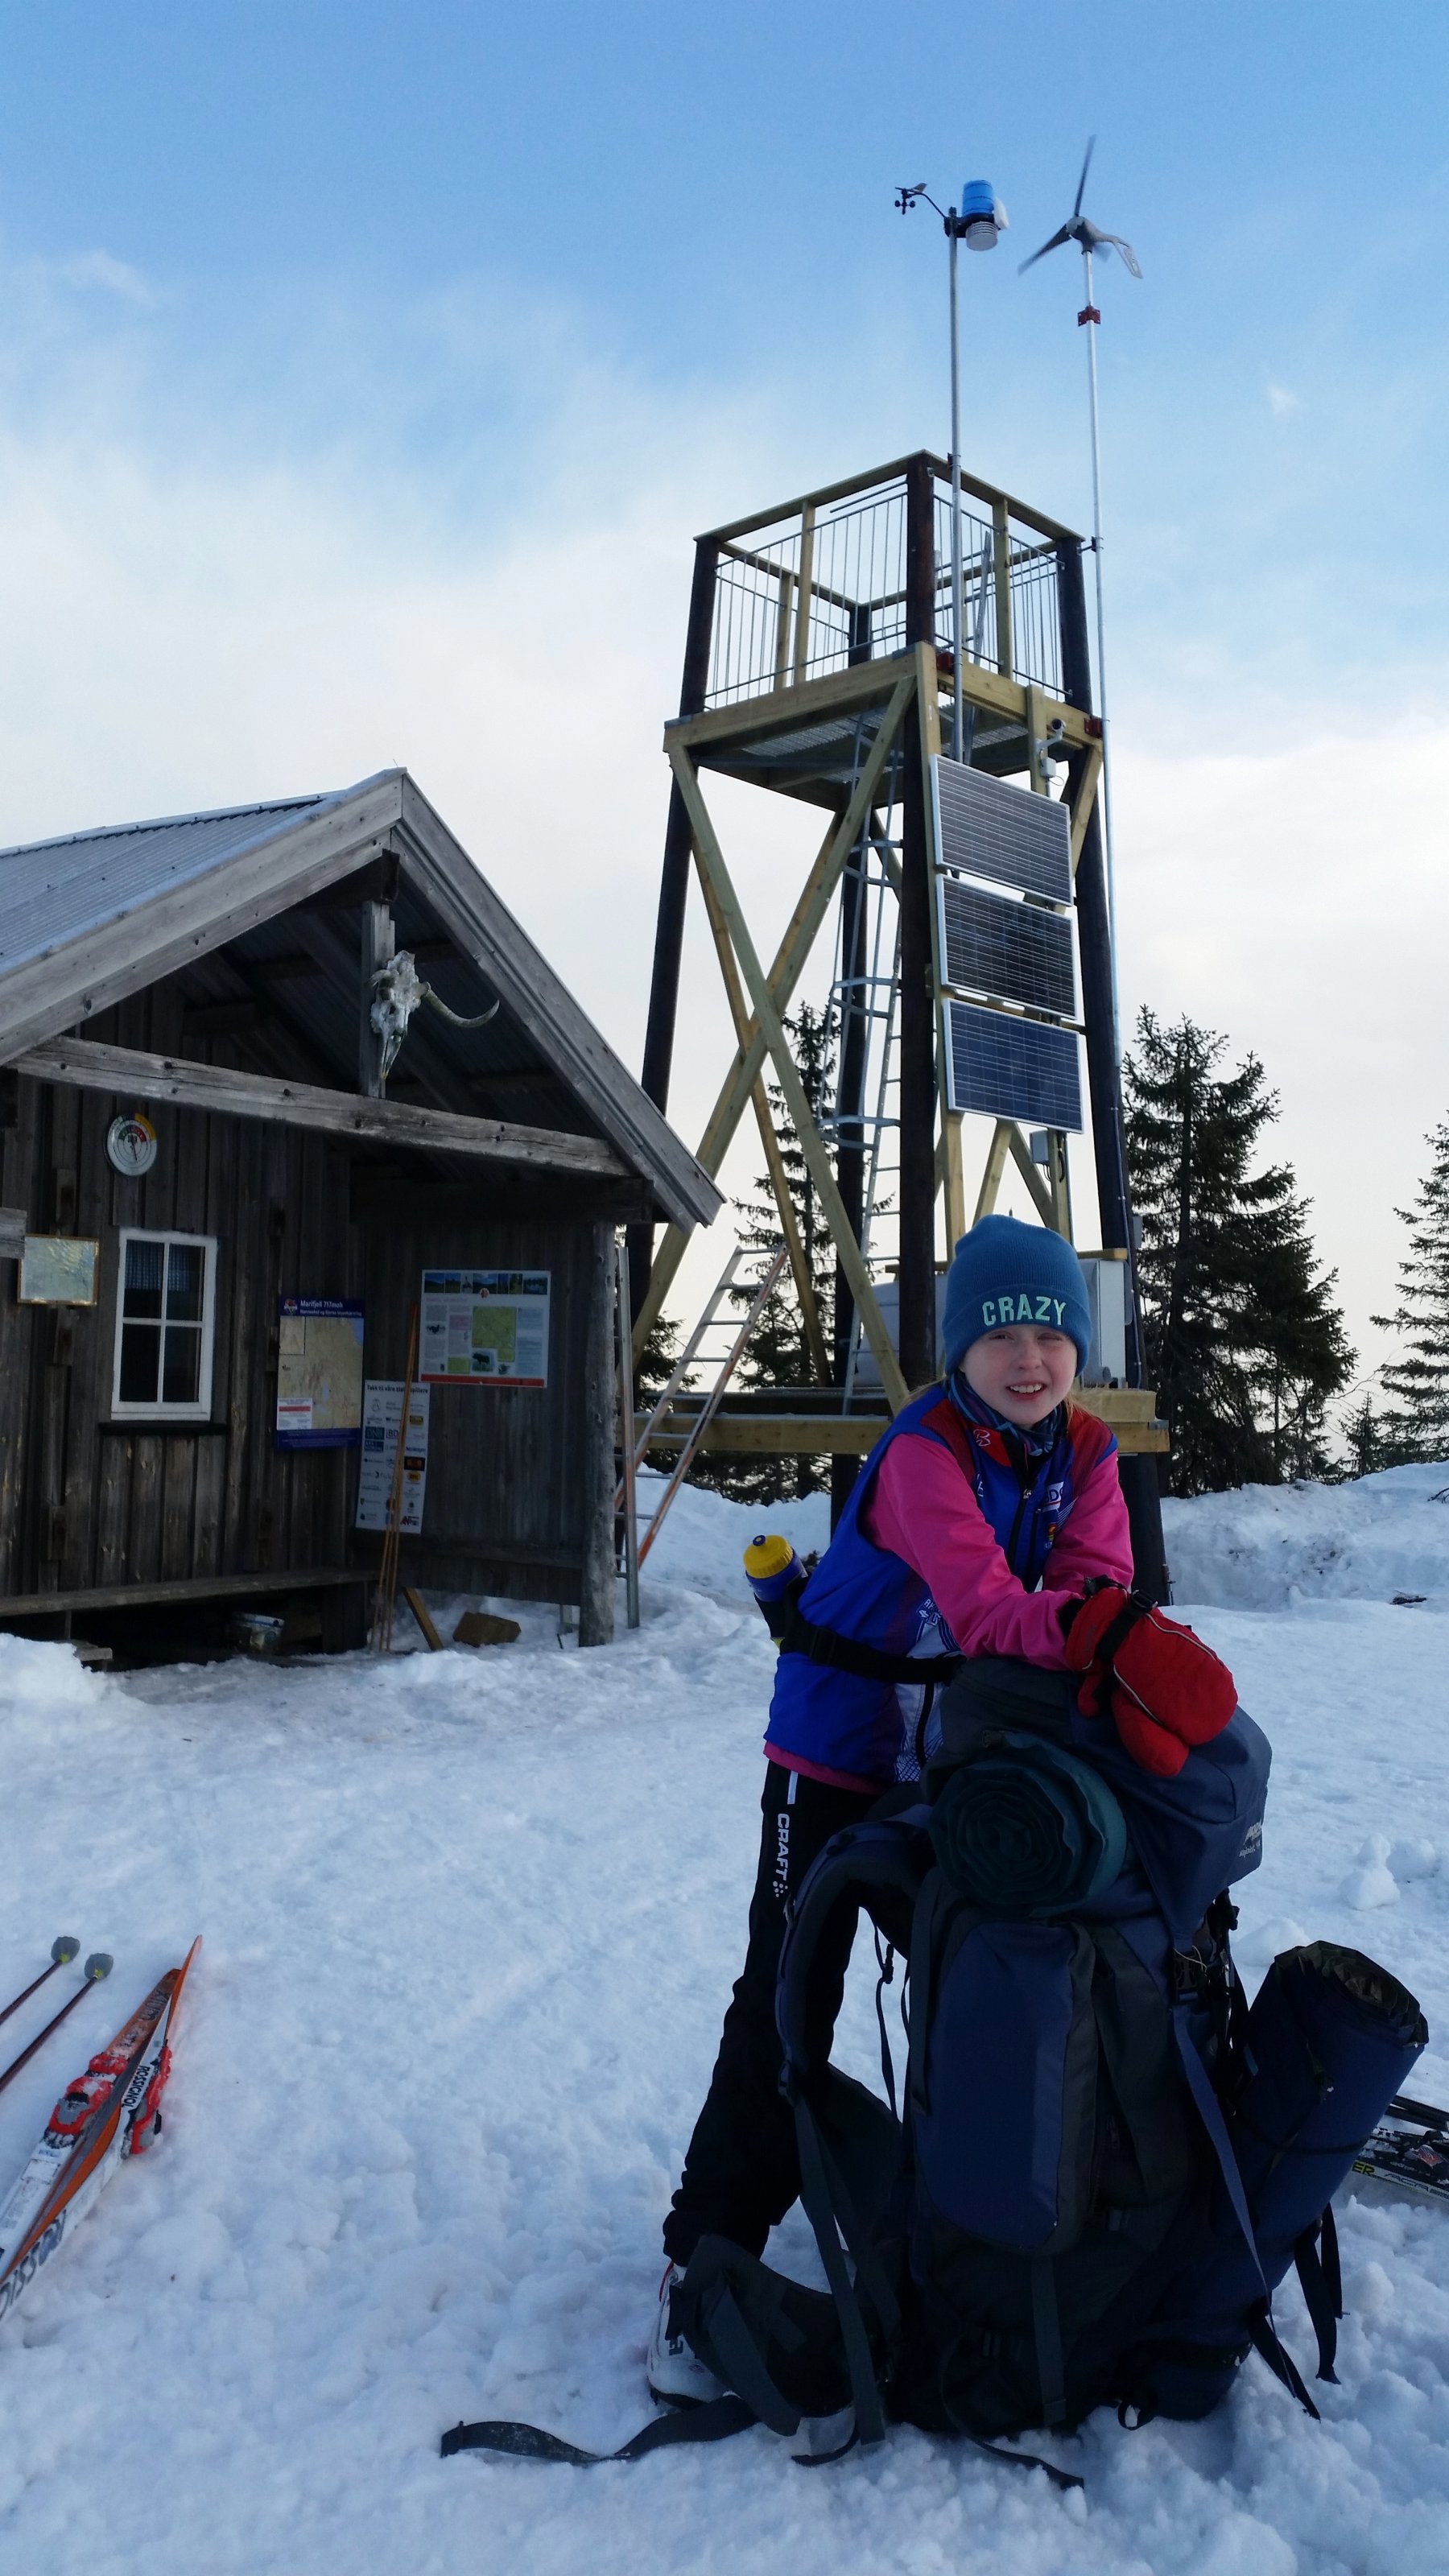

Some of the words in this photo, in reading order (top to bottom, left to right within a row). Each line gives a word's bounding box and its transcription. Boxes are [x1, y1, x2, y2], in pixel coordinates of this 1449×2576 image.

[982, 1294, 1067, 1326] CRAZY
[775, 1813, 790, 1880] CRAFT
[130, 2066, 151, 2107] ROSSIGNOL
